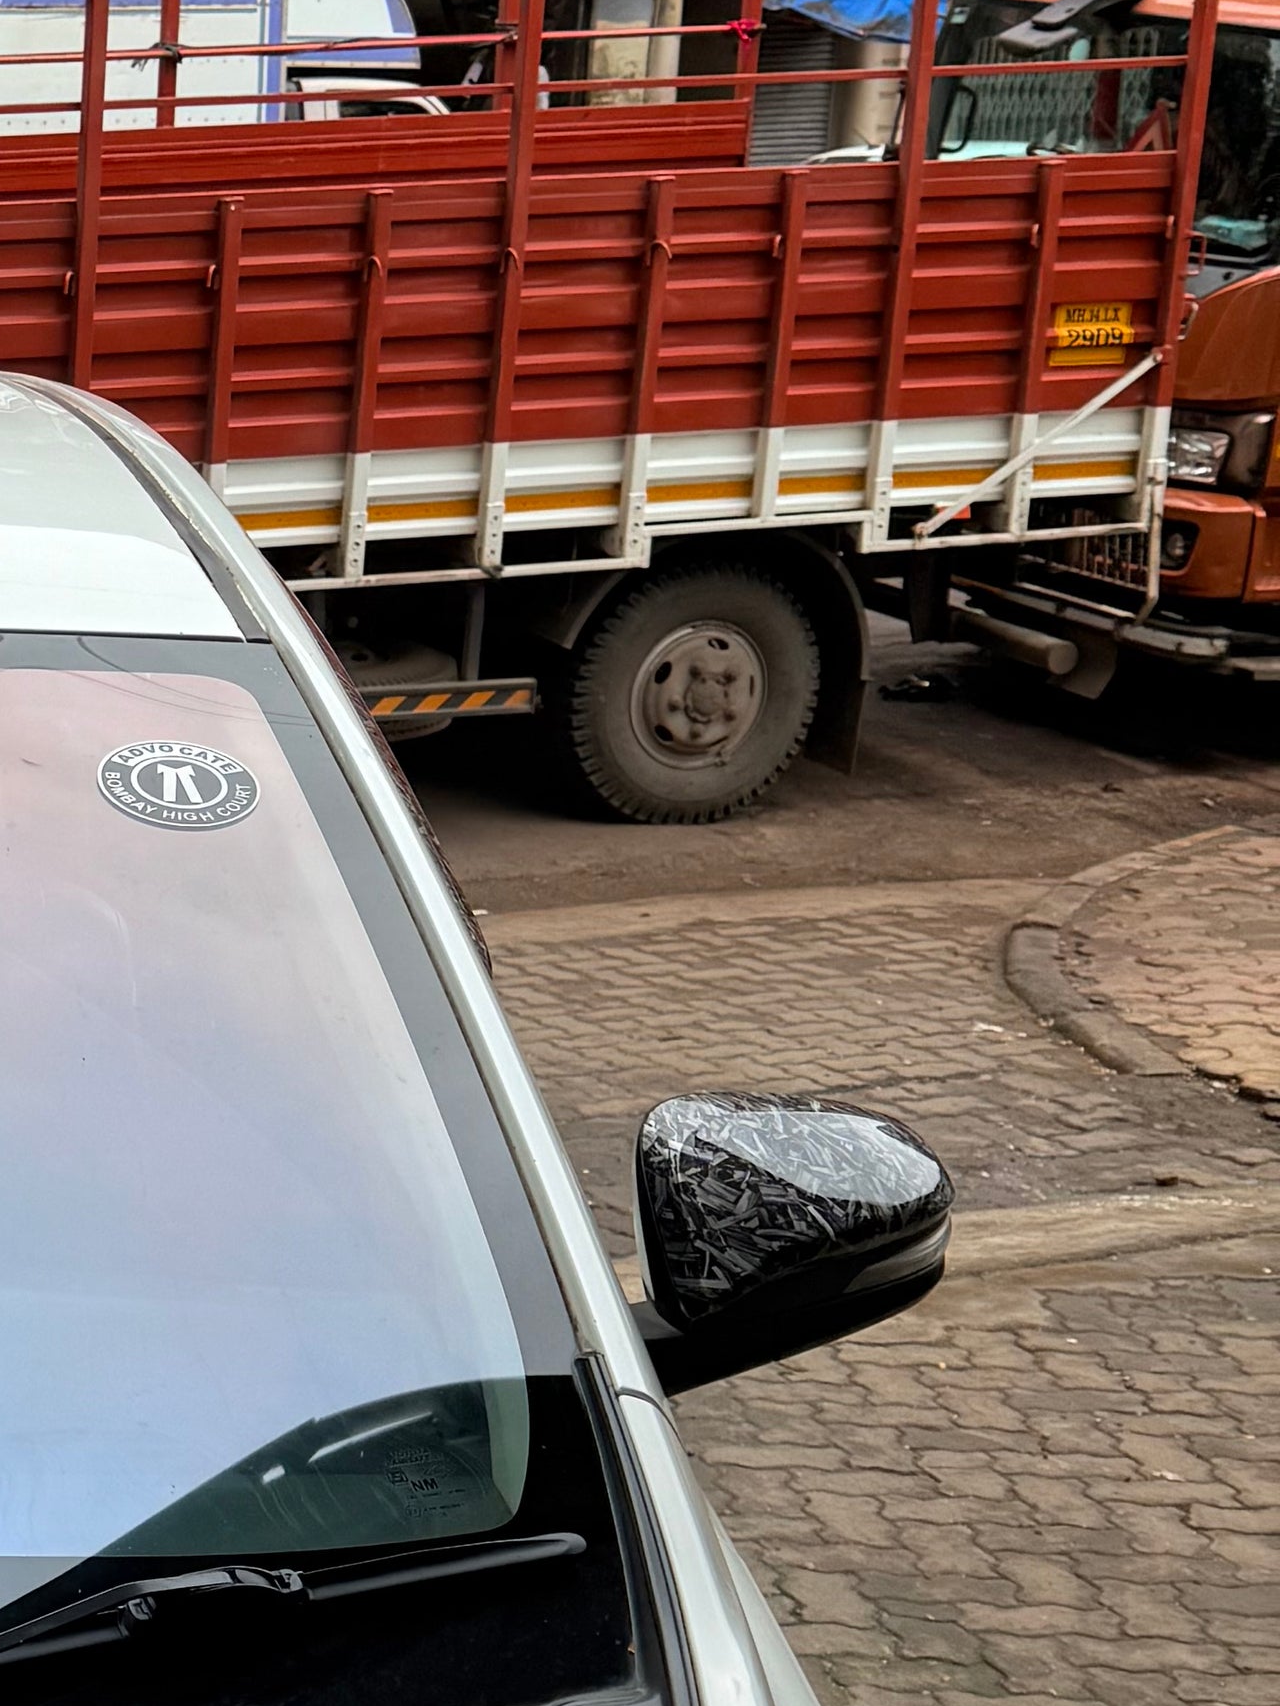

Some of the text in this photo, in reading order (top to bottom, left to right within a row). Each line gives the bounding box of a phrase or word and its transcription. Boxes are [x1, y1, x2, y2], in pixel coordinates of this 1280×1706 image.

[118, 743, 238, 776] ADVOCATE
[105, 771, 251, 822] BOMBAY HIGH COURT
